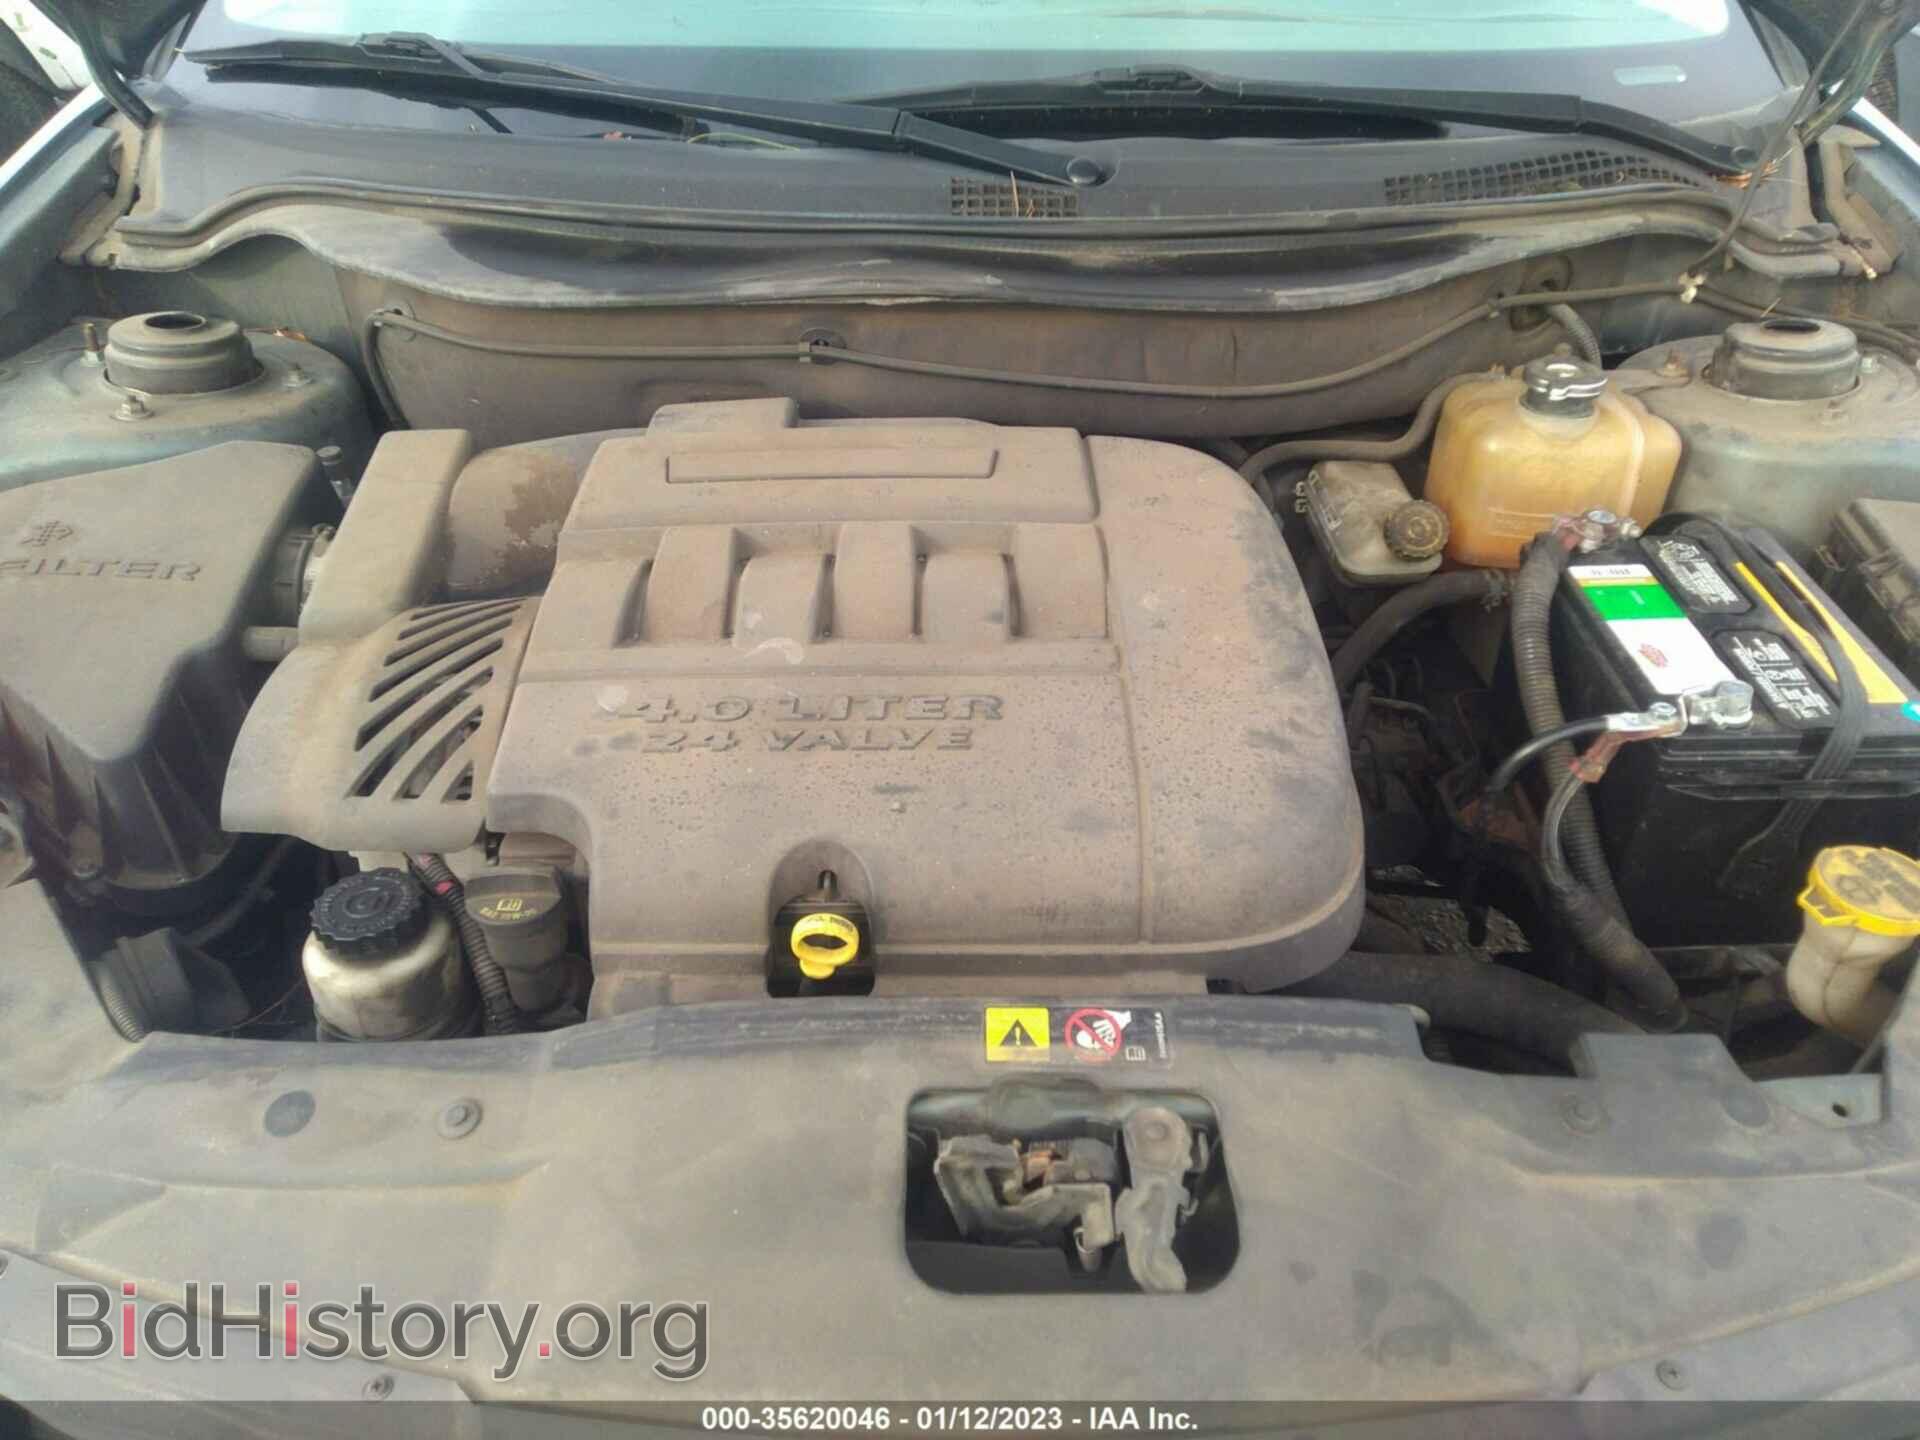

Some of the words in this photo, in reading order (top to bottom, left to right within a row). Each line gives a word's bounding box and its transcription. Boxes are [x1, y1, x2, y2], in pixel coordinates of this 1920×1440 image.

[0, 558, 202, 581] FILTER
[619, 695, 753, 723] 4.0
[775, 694, 1004, 721] LITER
[641, 728, 740, 753] 24
[765, 727, 974, 752] VALVE
